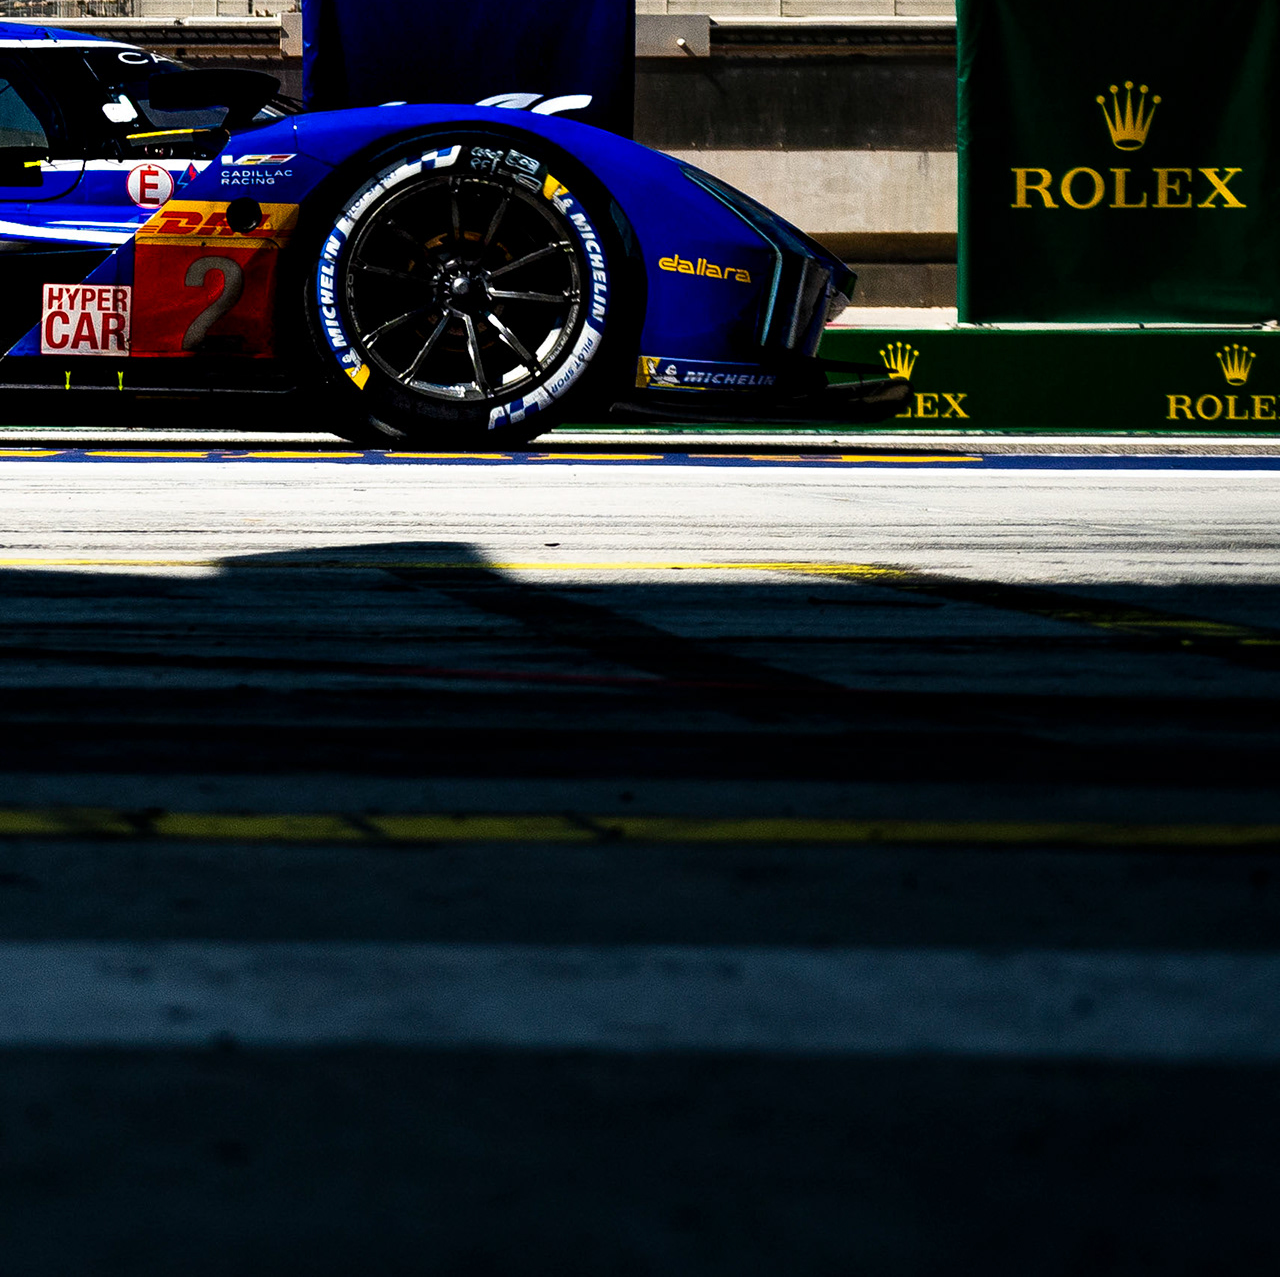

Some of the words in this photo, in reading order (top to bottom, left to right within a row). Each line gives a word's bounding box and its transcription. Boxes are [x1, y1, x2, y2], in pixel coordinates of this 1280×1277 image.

[139, 169, 160, 205] E
[221, 169, 293, 177] CADILLAC
[221, 177, 276, 186] RACING
[1009, 165, 1248, 210] ROLEX
[568, 212, 608, 323] MICHELIN
[658, 254, 752, 284] dallara
[47, 287, 128, 312] HYPER
[181, 255, 243, 351] 2
[318, 235, 348, 349] MICHELIN
[44, 310, 127, 351] CAR
[682, 370, 777, 386] MICHELIN
[1165, 394, 1280, 421] ROLE
